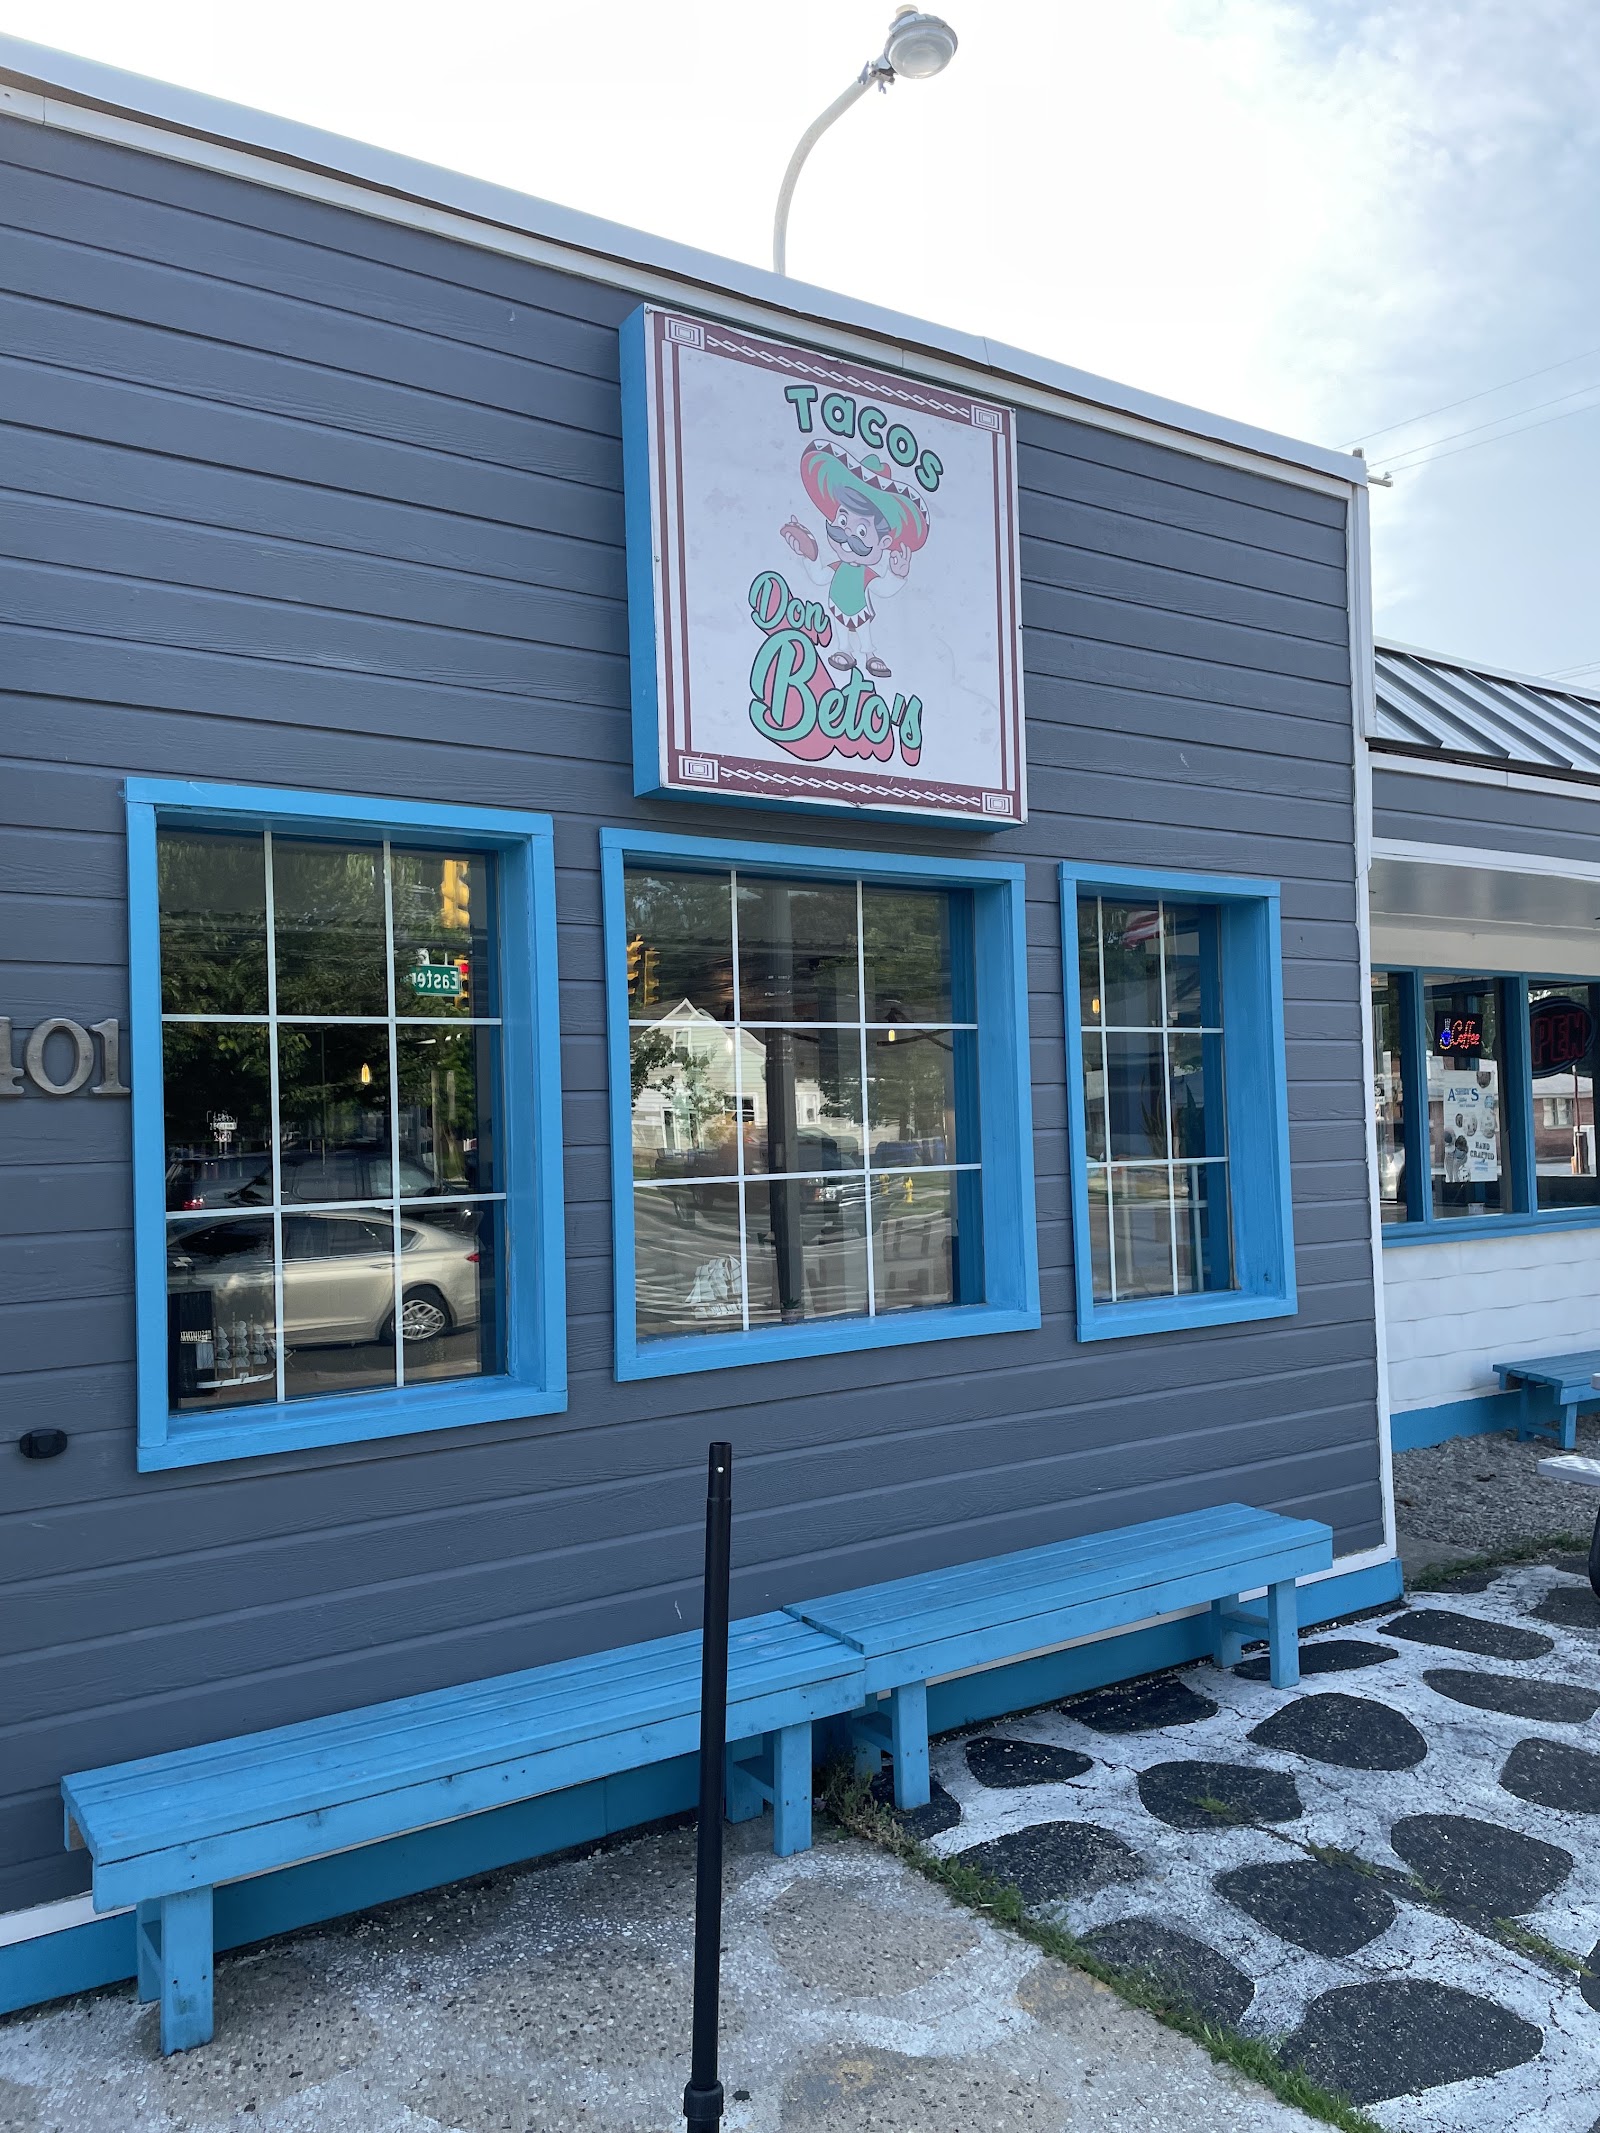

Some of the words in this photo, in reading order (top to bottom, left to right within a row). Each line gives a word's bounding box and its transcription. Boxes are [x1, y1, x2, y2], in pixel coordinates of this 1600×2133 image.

[784, 384, 944, 492] Tacos
[749, 571, 832, 640] Don
[749, 628, 923, 762] Beto's
[1530, 1009, 1586, 1065] PEN
